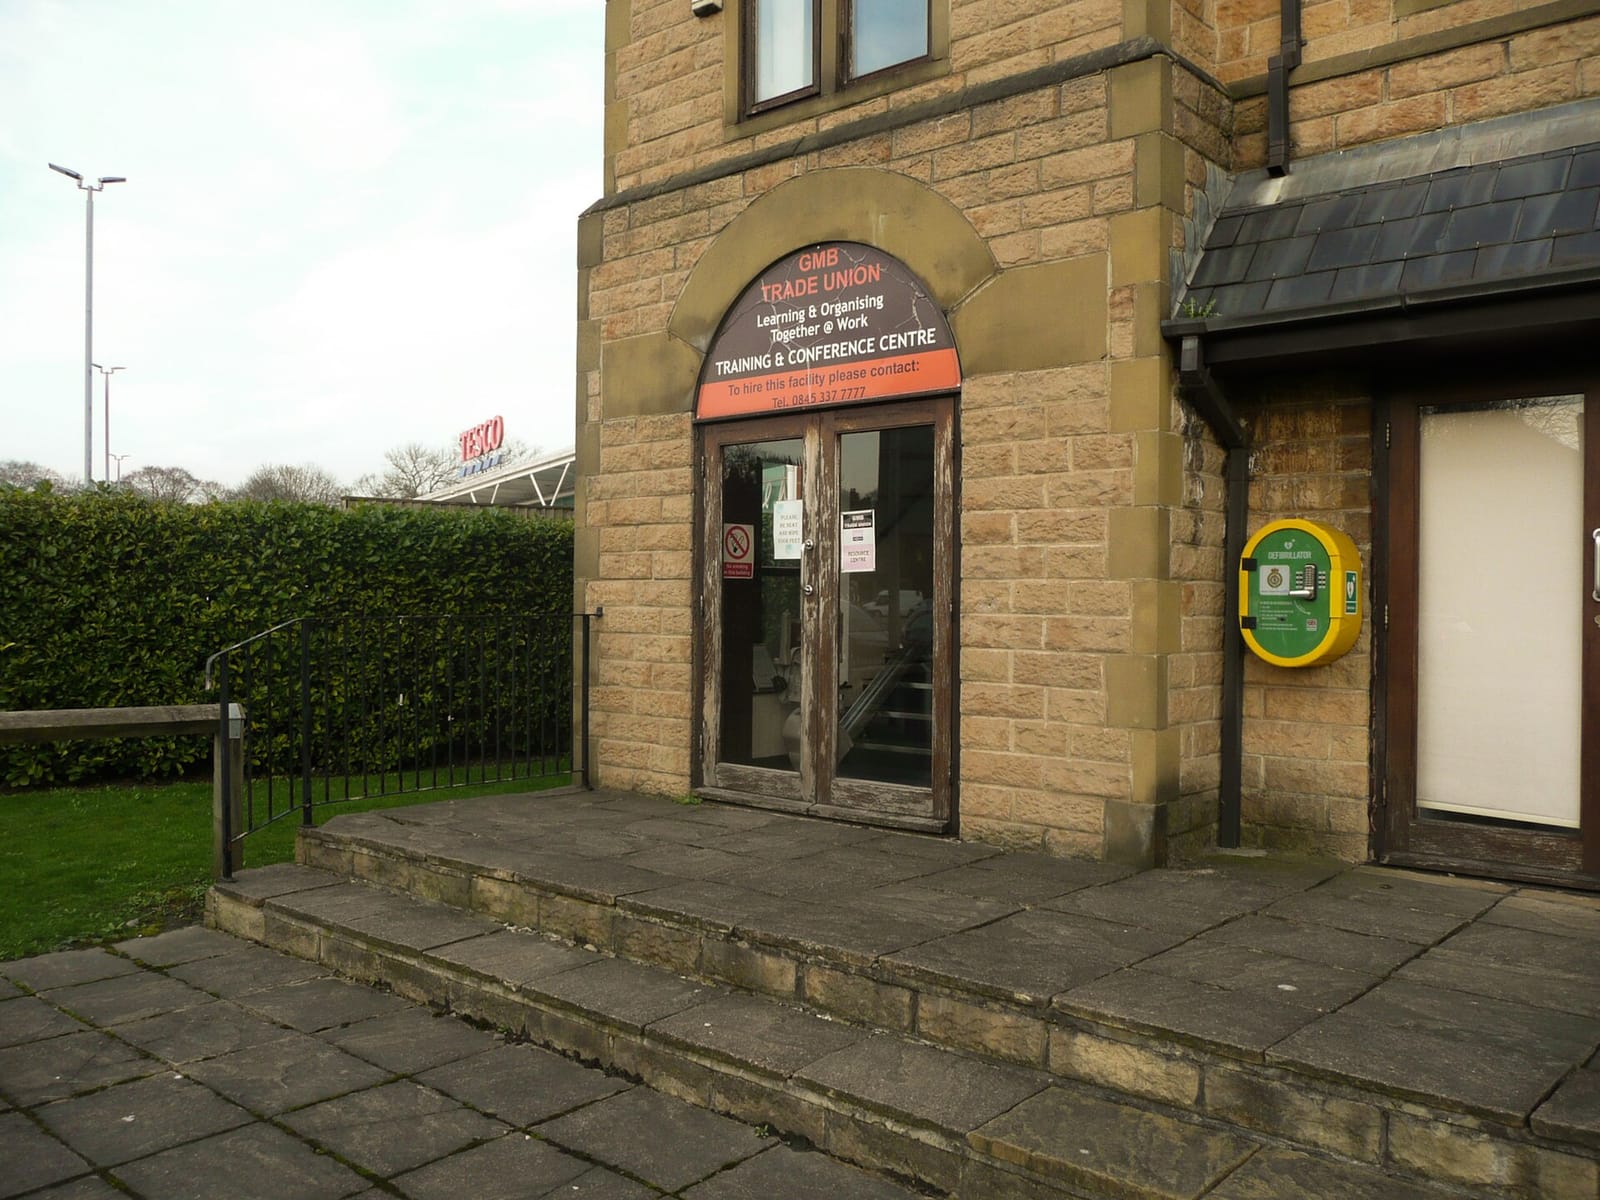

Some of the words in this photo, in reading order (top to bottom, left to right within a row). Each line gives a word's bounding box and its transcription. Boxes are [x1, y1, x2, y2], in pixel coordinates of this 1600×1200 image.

[799, 248, 839, 271] GMB
[761, 276, 818, 302] TRADE
[823, 264, 880, 291] UNION
[757, 309, 805, 328] Learning
[808, 304, 817, 318] &
[821, 295, 884, 317] Organising
[770, 324, 820, 343] Together
[823, 321, 833, 334] @
[837, 313, 868, 331] Work
[715, 354, 771, 375] TRAINING
[775, 352, 784, 366] &
[788, 337, 875, 364] CONFERENCE
[880, 328, 936, 351] CENTRE
[728, 385, 740, 396] To
[743, 383, 763, 394] hire
[766, 379, 785, 391] this
[789, 373, 825, 388] facility
[829, 368, 866, 385] please
[870, 360, 920, 376] contact:
[772, 397, 788, 408] Tel.
[792, 391, 816, 405] 0845
[818, 390, 837, 402] 337
[841, 386, 866, 400] 7777
[460, 415, 504, 463] TESCO
[1267, 551, 1311, 560] DEFIBRILLATOR
